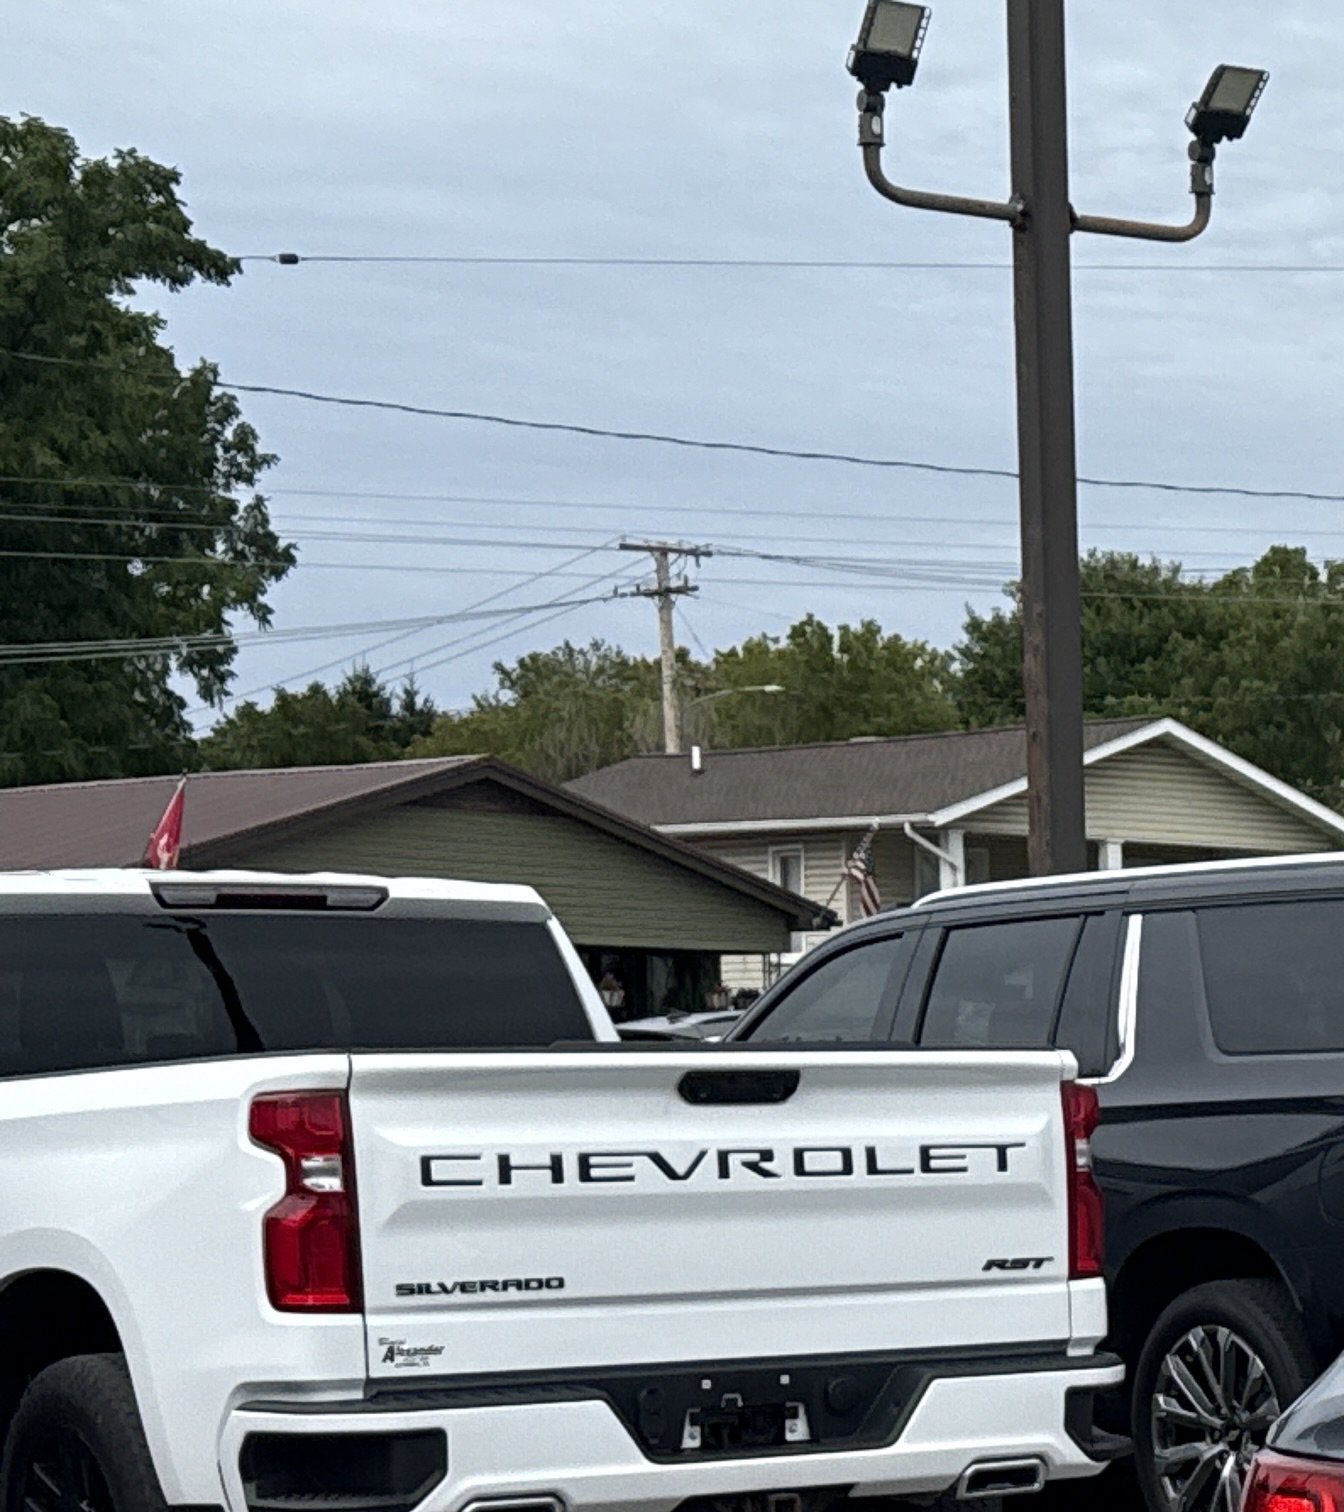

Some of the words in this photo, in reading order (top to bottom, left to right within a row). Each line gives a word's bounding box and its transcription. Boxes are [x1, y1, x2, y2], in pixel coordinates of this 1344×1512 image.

[420, 1142, 1026, 1187] CHEVROLET
[981, 1256, 1055, 1272] RST
[395, 1276, 565, 1297] SILVERADO
